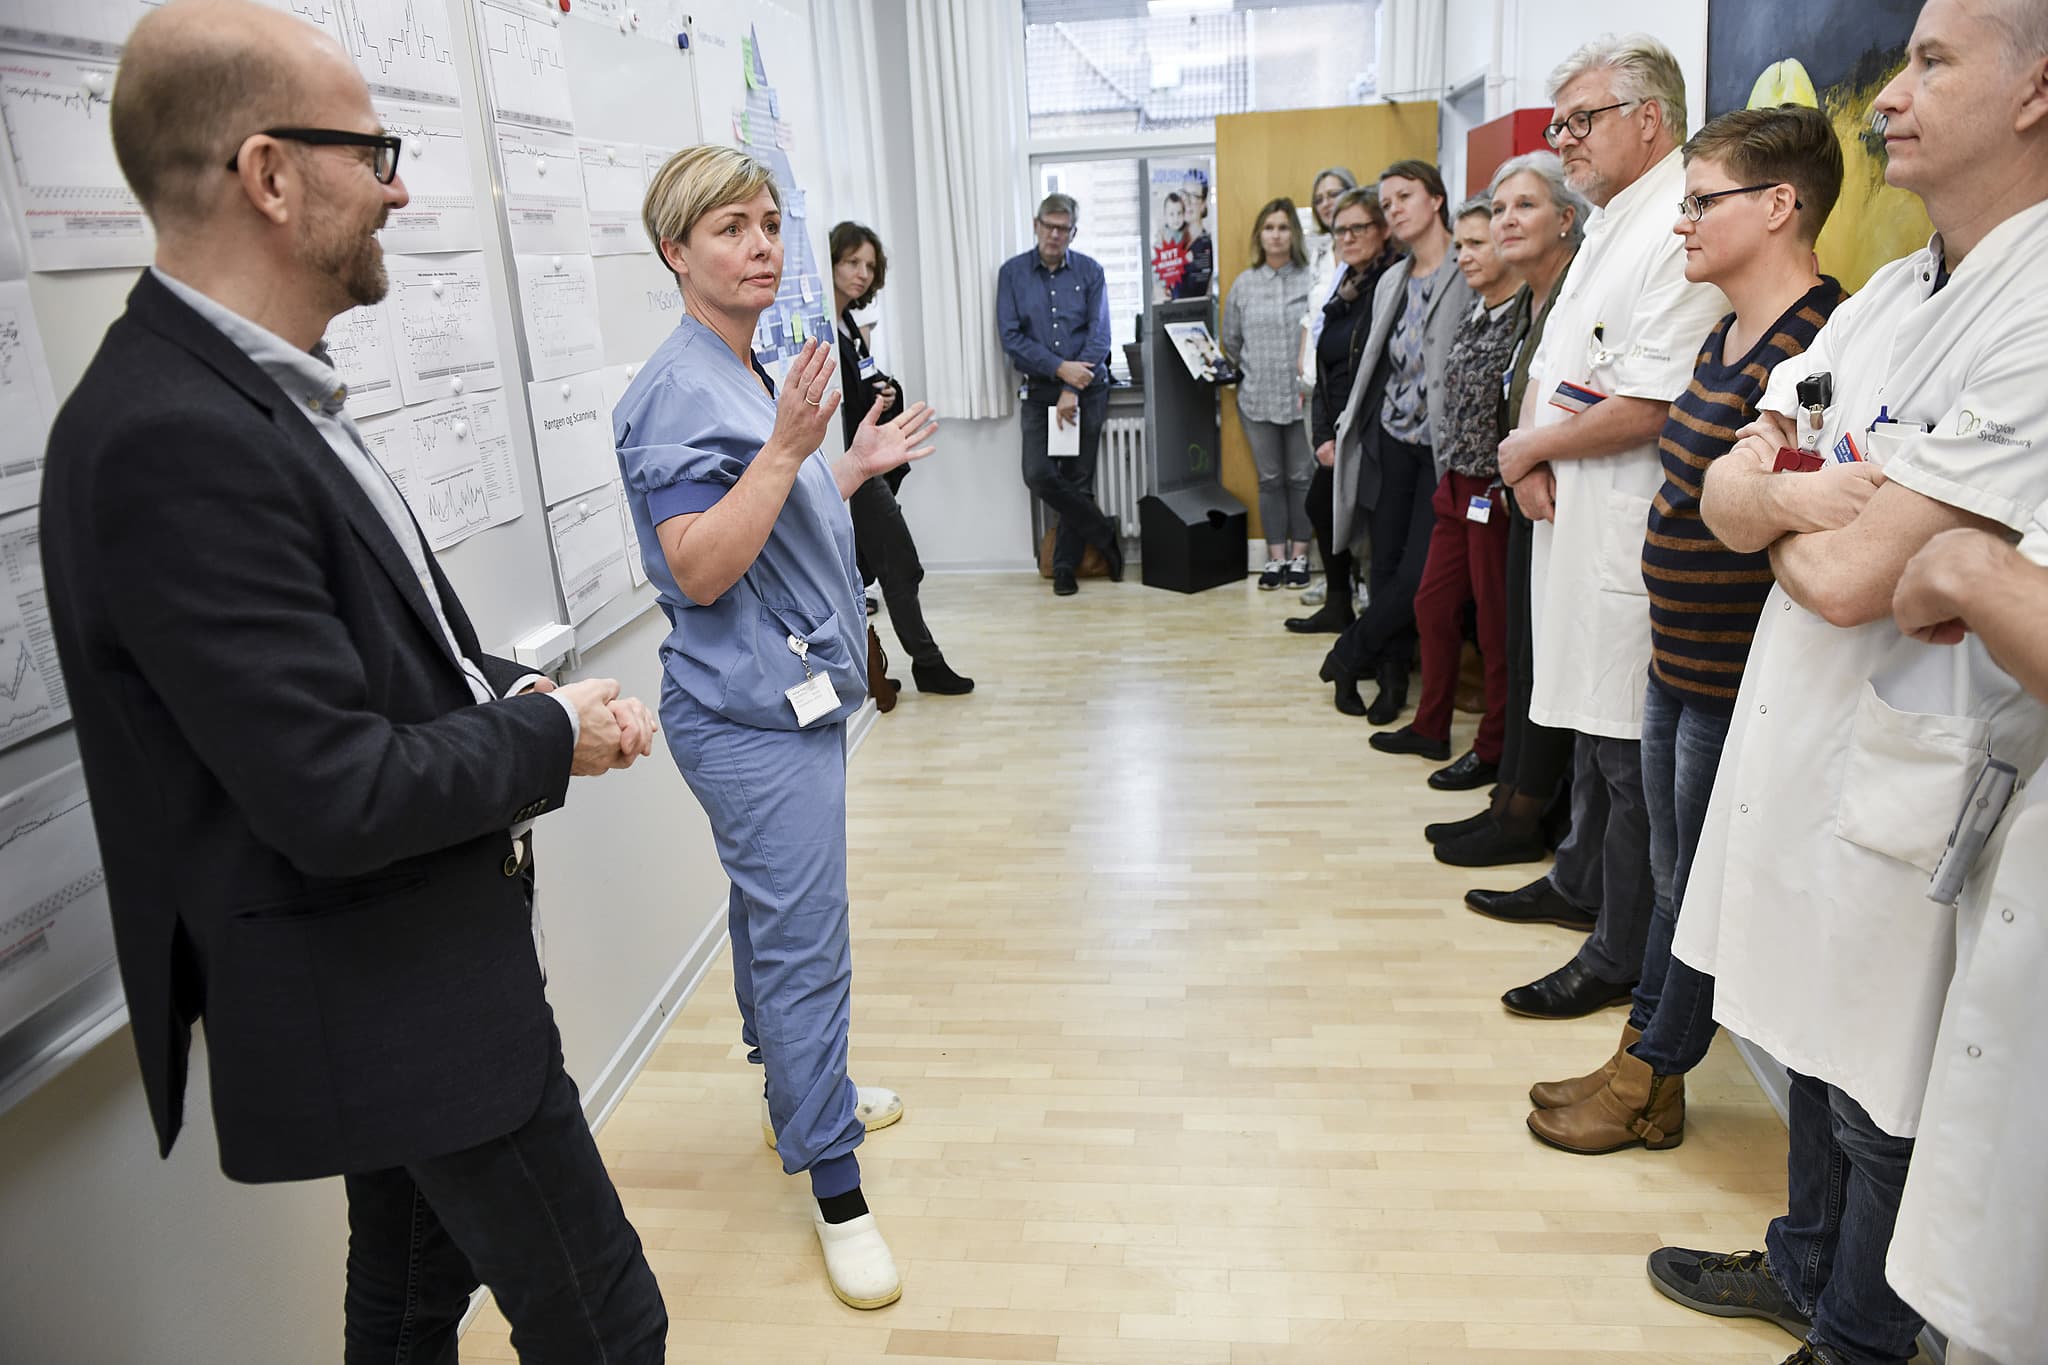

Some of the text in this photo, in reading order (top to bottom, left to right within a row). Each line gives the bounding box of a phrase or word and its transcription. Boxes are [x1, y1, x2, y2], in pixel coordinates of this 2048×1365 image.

[565, 415, 574, 427] og
[572, 410, 597, 423] Scanning
[1986, 420, 2016, 434] Region
